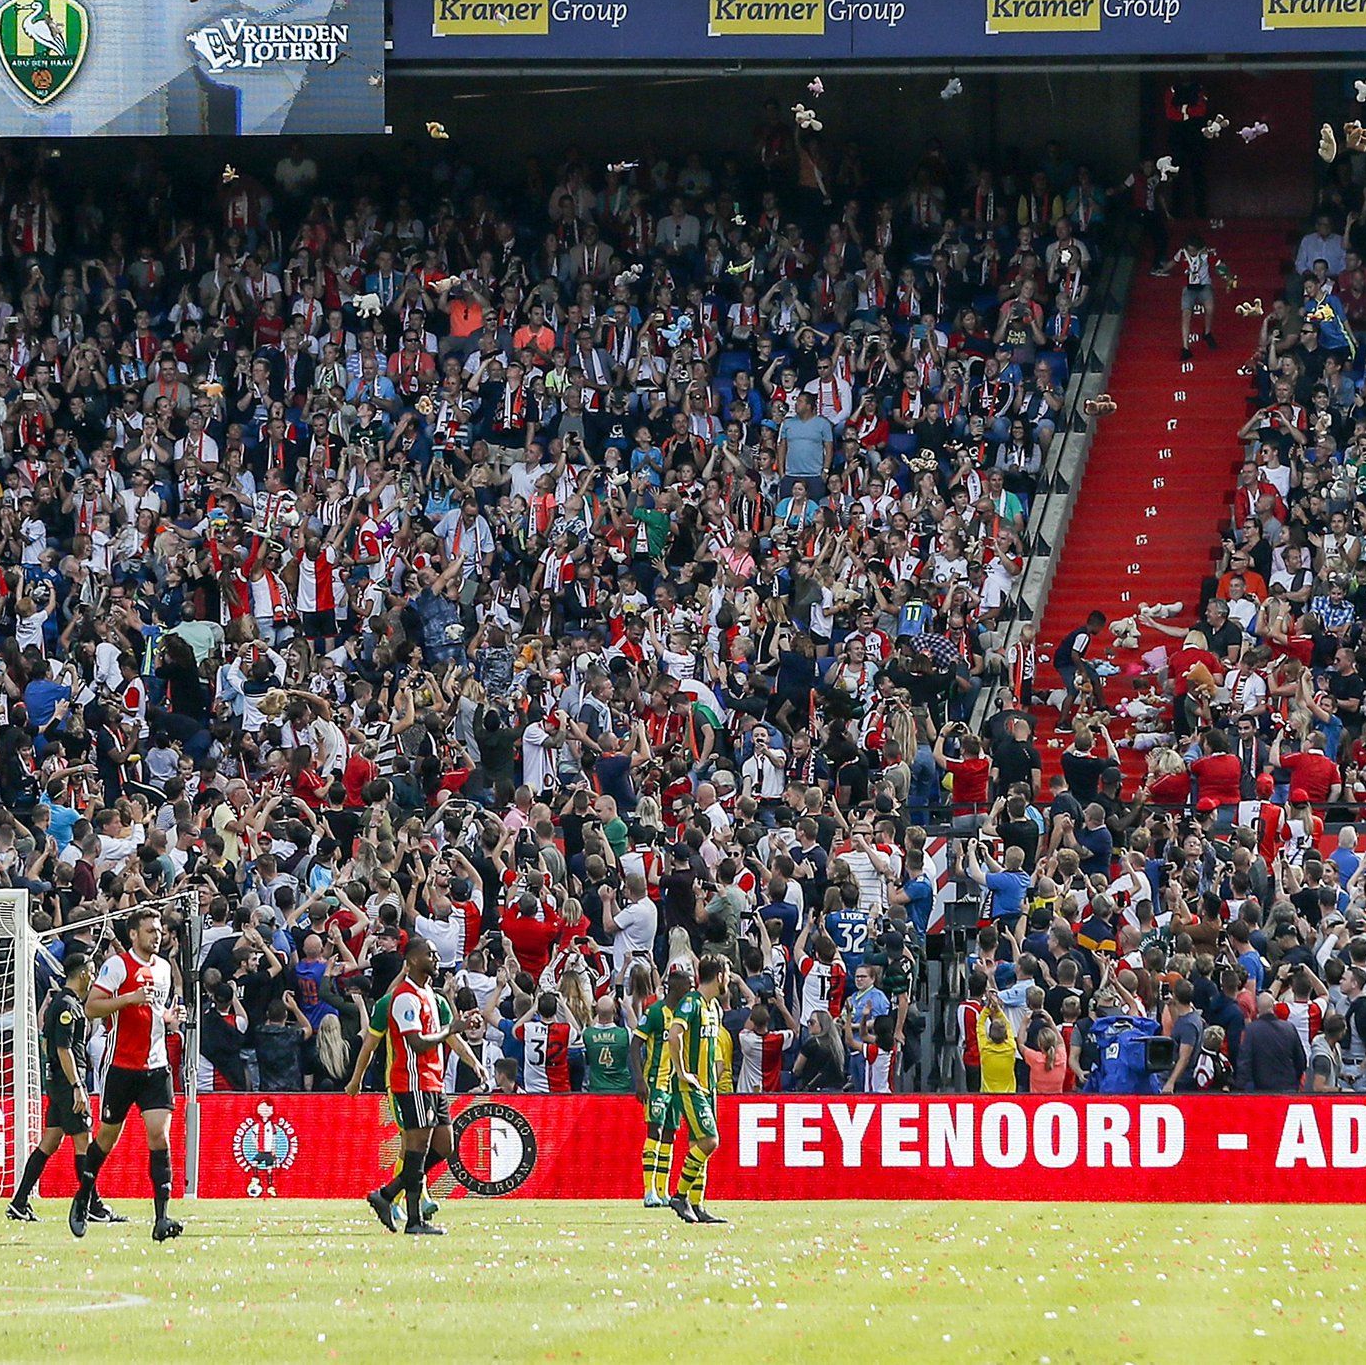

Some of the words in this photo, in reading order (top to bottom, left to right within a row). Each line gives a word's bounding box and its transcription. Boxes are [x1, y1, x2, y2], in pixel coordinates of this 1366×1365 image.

[222, 18, 349, 43] VRIENDEN
[243, 42, 339, 68] LOTERIJ
[1173, 390, 1186, 402] 18
[1166, 419, 1178, 430] 17
[1158, 448, 1172, 460] 16
[1152, 477, 1165, 489] 15
[1144, 506, 1157, 517] 14
[1126, 563, 1141, 574] 12
[906, 606, 922, 621] 11
[837, 922, 870, 954] 32
[531, 1038, 564, 1067] 32
[598, 1045, 614, 1068] 4
[739, 1103, 1186, 1169] FEYENOORD
